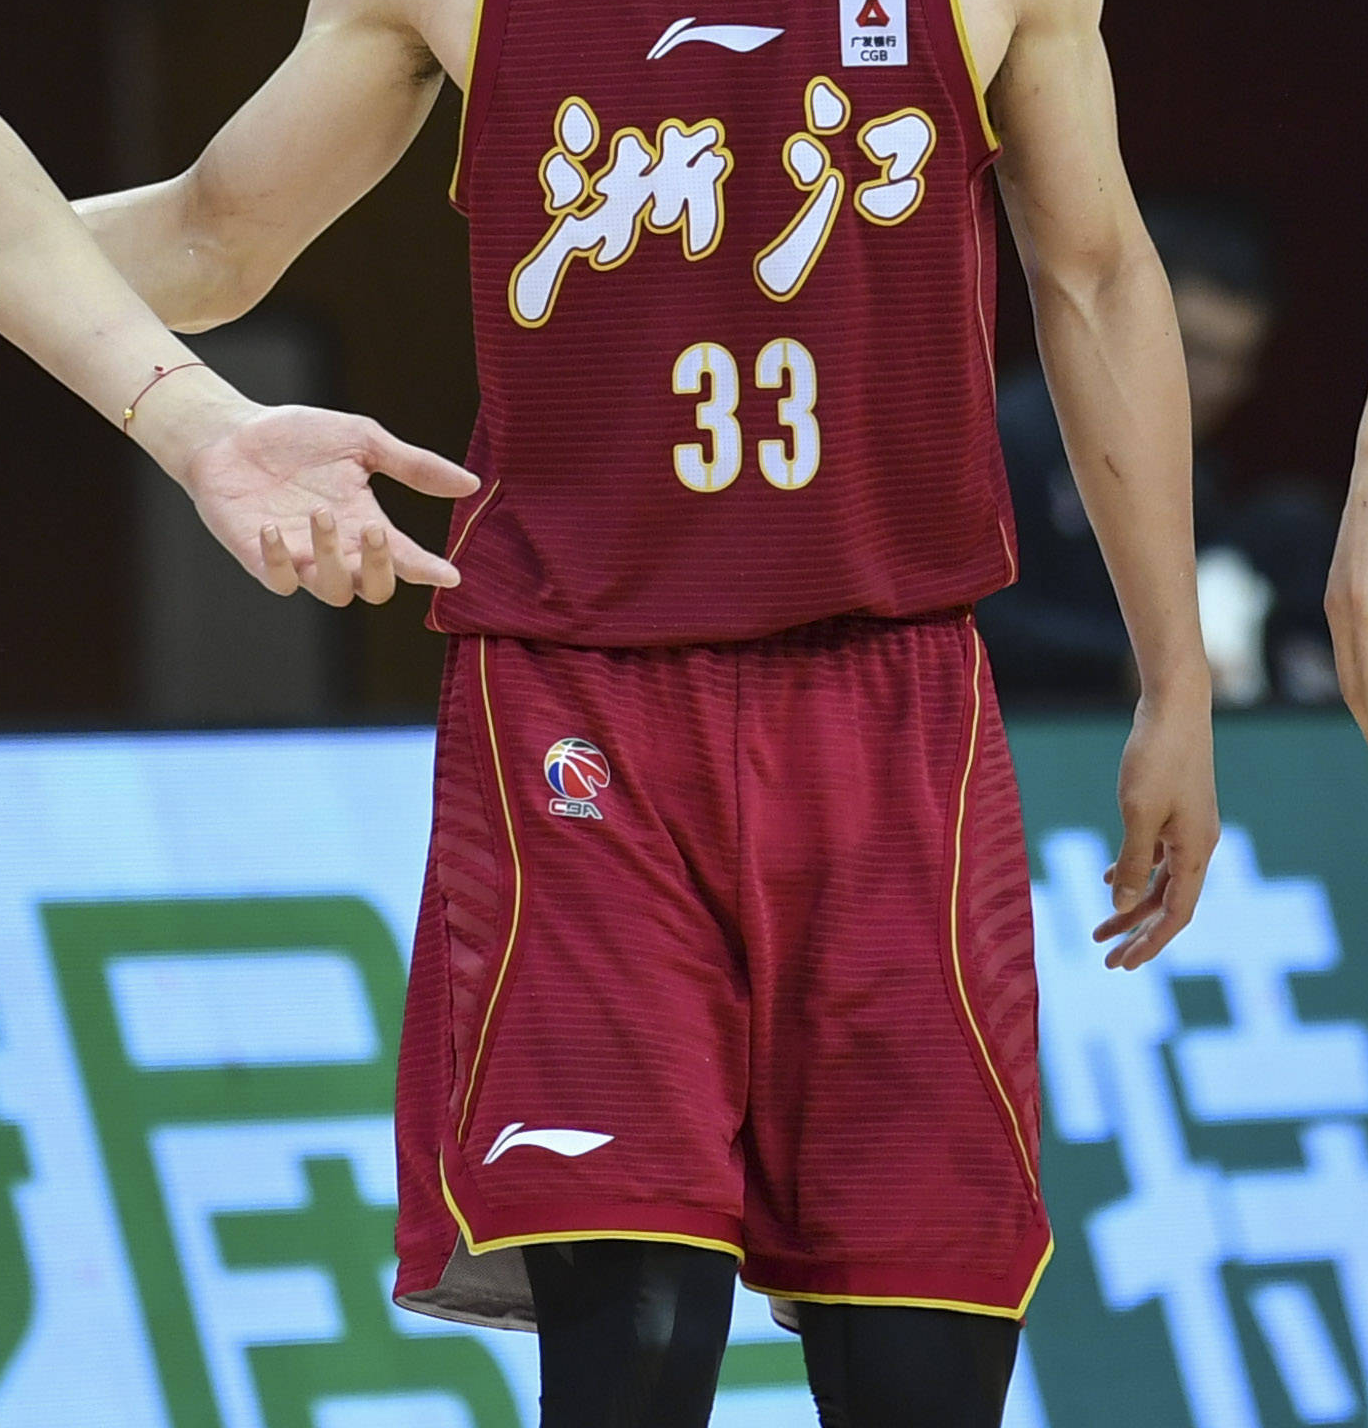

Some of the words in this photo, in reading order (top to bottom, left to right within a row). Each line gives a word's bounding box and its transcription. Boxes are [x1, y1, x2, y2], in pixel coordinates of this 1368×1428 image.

[850, 35, 897, 48] 广发银行
[860, 49, 889, 62] CGB
[508, 76, 936, 328] 浙江
[672, 337, 821, 493] 33
[548, 798, 604, 820] CBA
